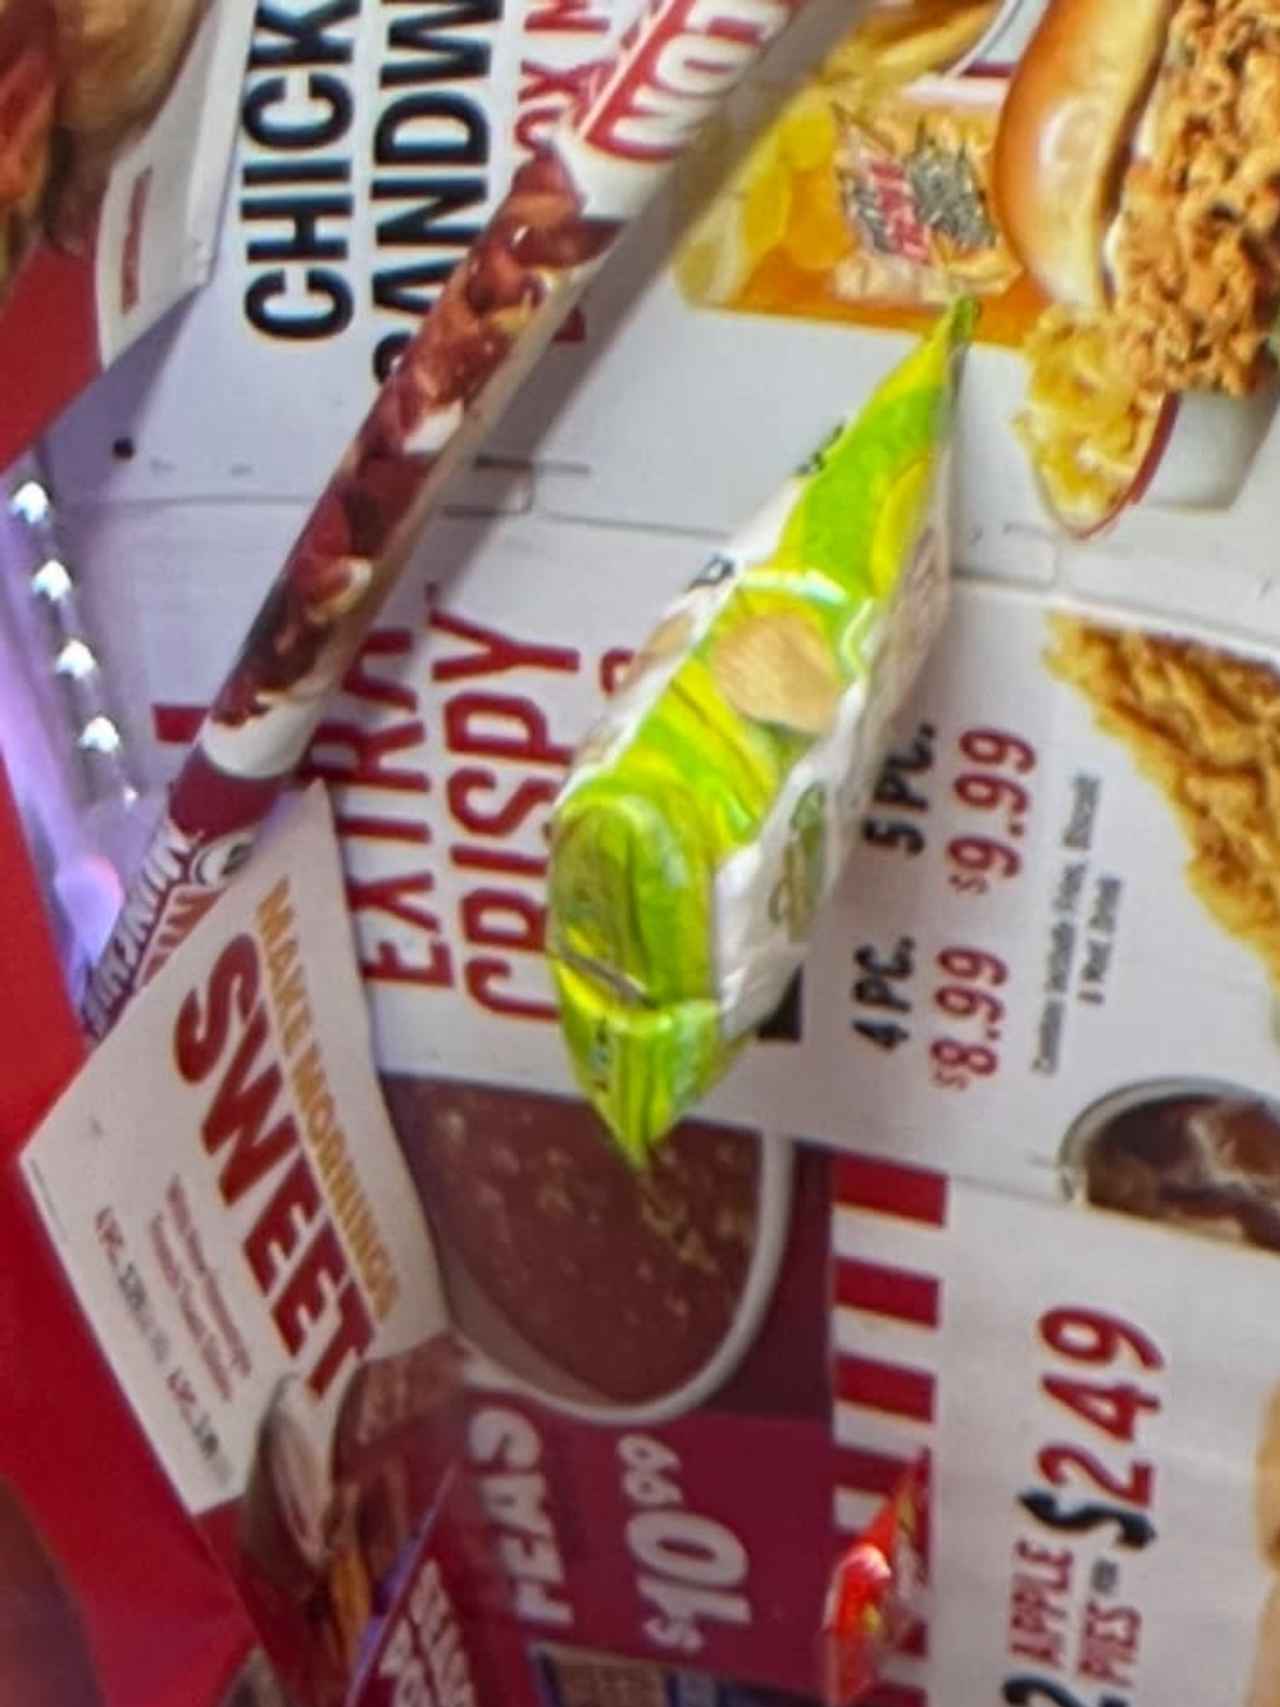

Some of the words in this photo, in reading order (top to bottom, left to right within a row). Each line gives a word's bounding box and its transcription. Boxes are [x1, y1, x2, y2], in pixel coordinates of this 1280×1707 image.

[946, 726, 1040, 895] $9.99
[174, 934, 378, 1398] SWEET
[1010, 1541, 1076, 1666] APPLE
[1078, 1601, 1143, 1691] PIES
